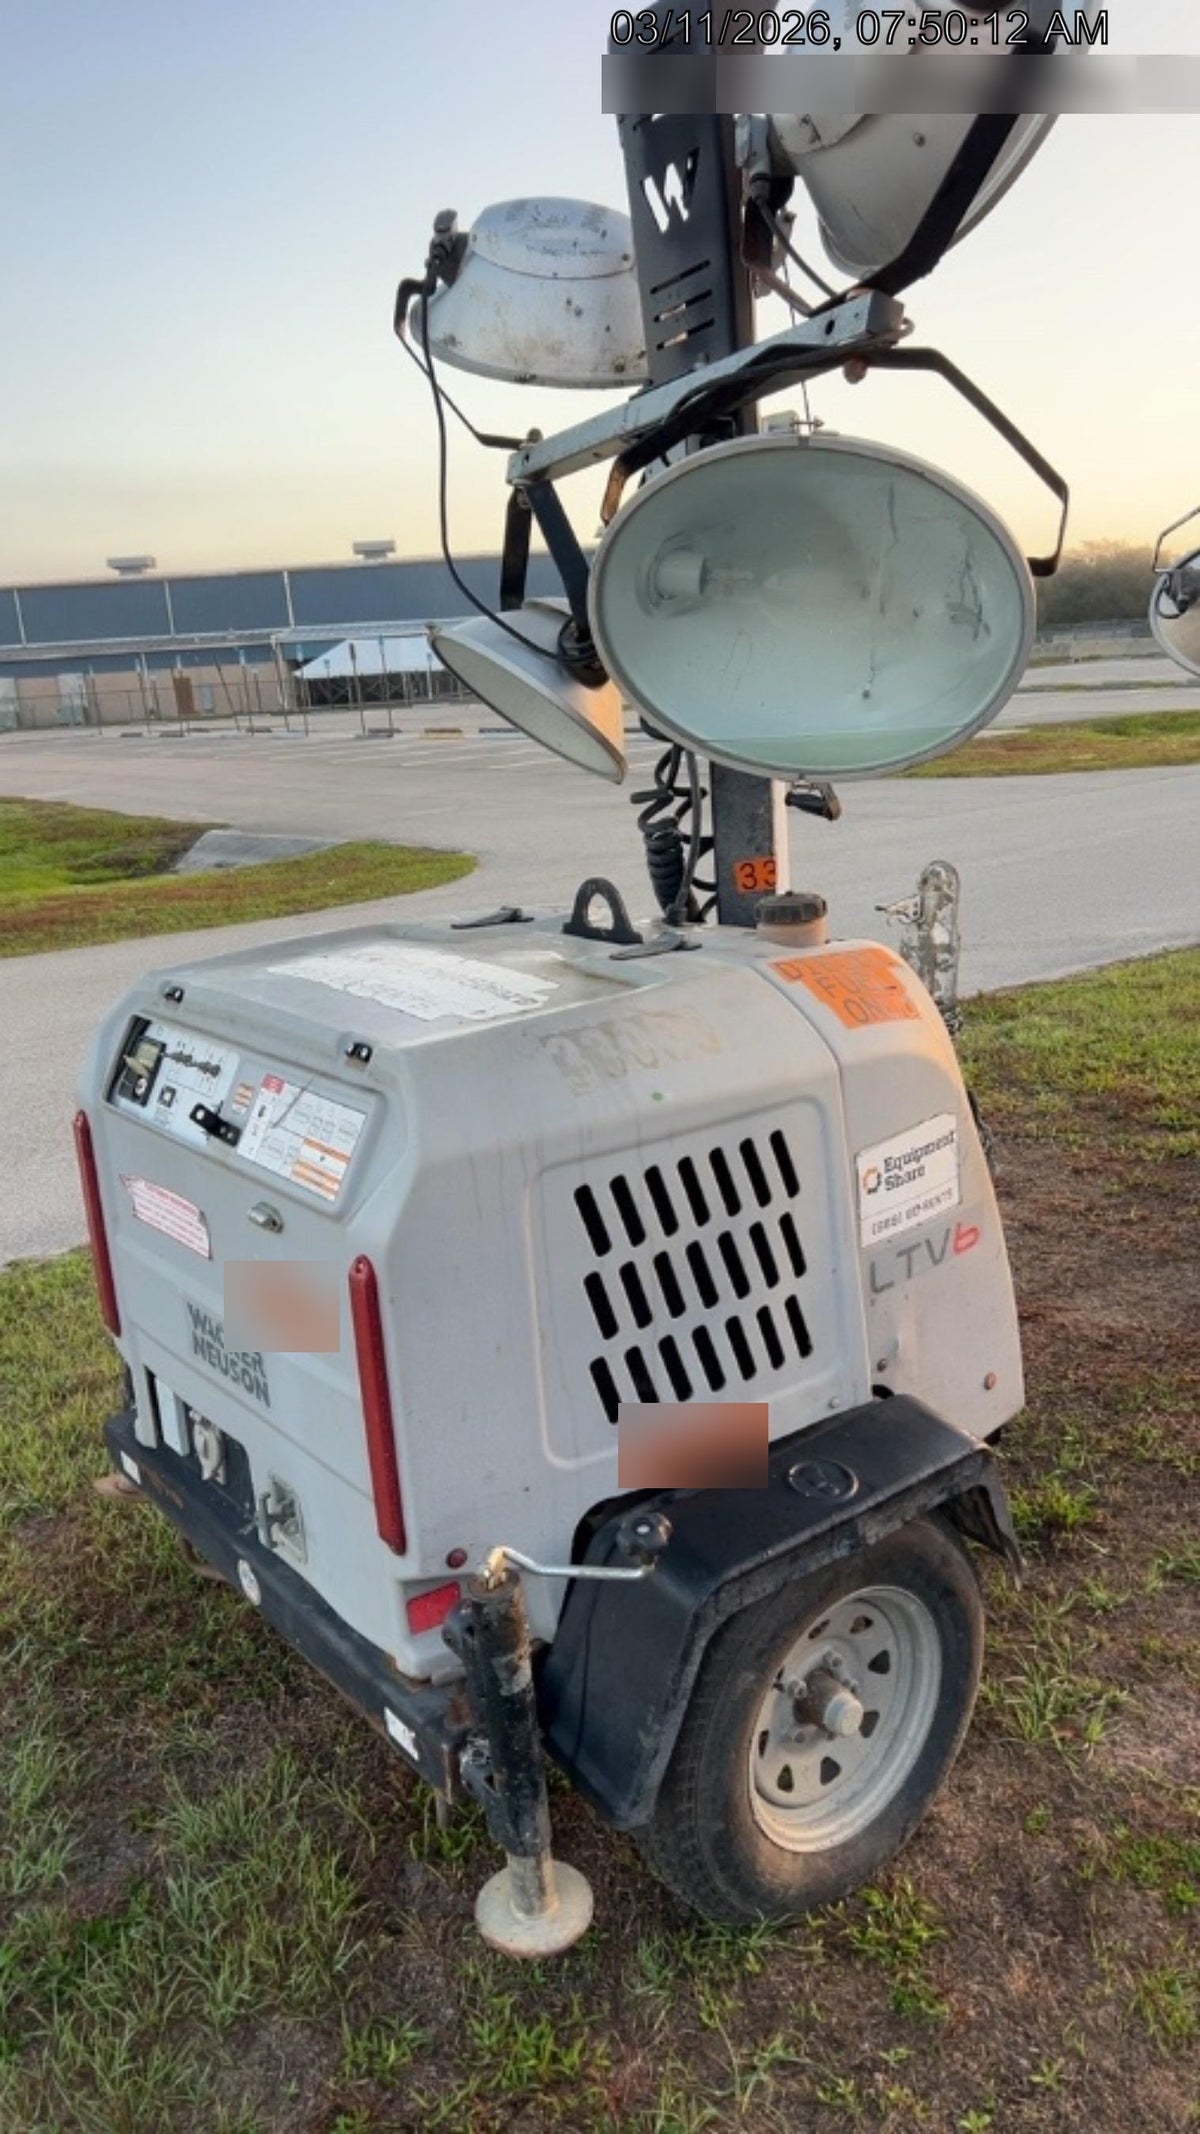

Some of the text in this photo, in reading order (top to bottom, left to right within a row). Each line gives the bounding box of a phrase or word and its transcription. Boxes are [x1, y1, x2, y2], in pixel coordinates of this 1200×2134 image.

[884, 1131, 954, 1173] Equipment
[884, 1165, 926, 1191] Share
[870, 1221, 980, 1293] LTV6
[187, 1301, 267, 1379] WACER
[192, 1331, 271, 1408] NEUSON
